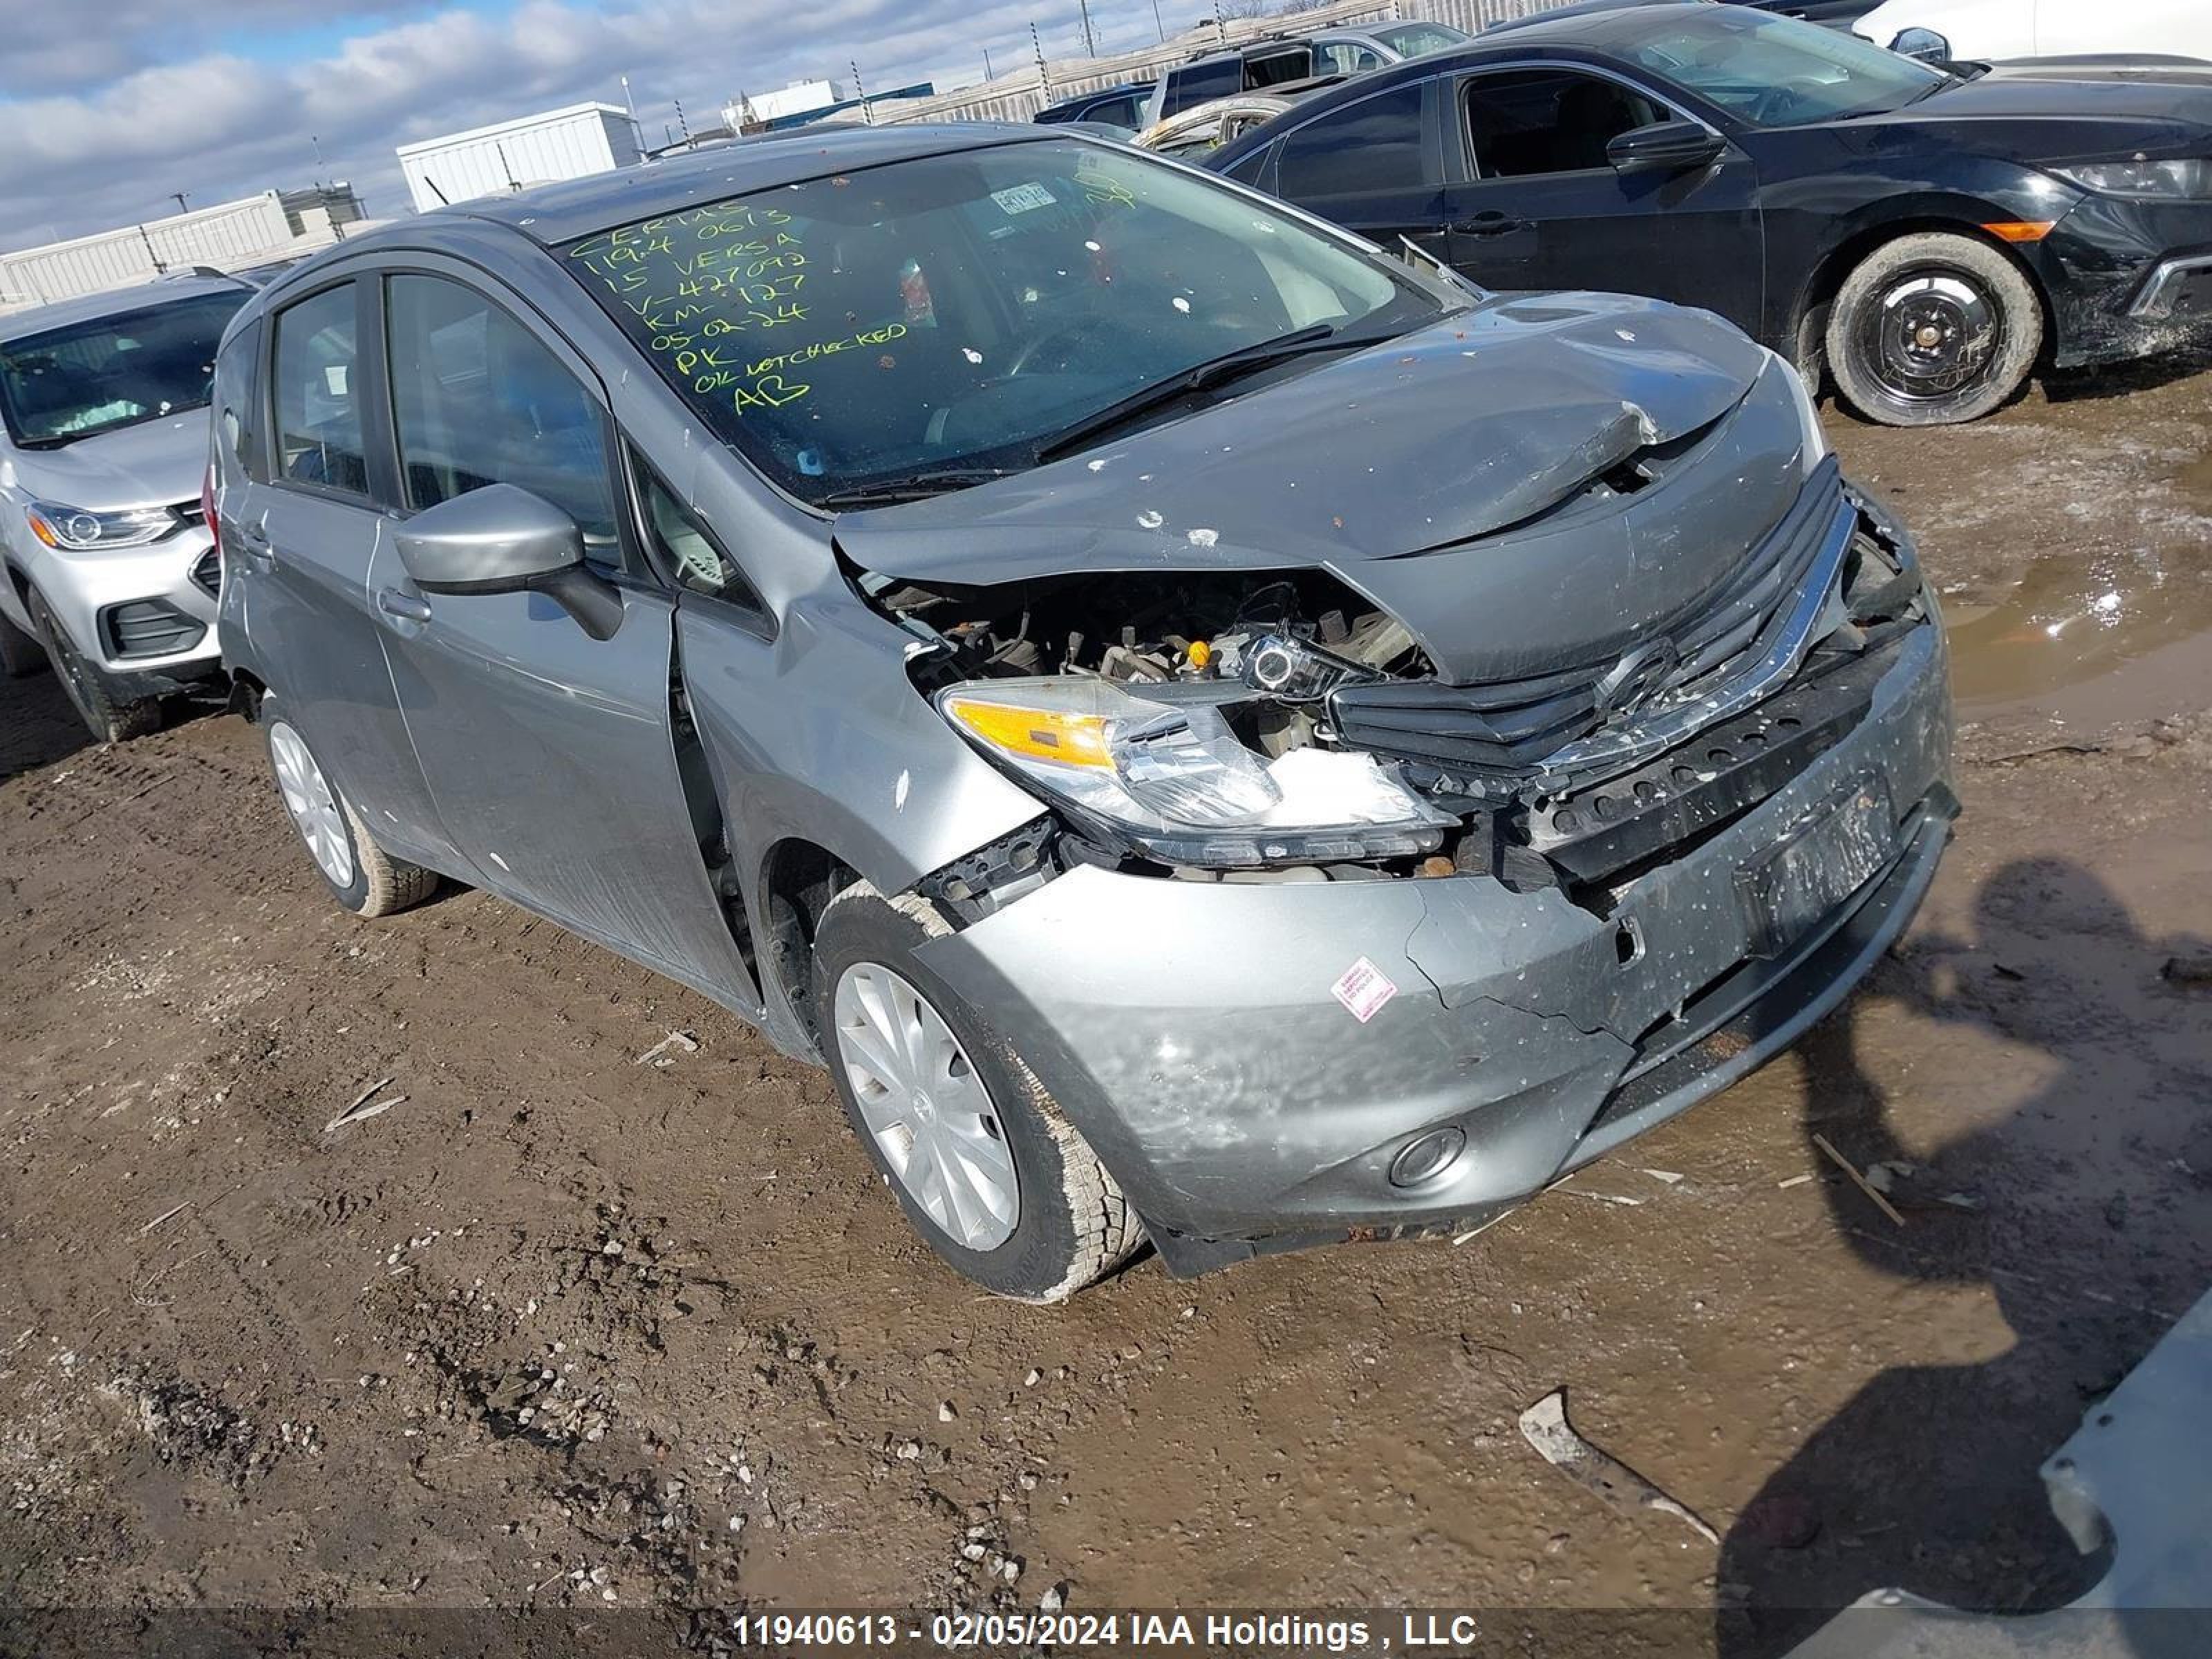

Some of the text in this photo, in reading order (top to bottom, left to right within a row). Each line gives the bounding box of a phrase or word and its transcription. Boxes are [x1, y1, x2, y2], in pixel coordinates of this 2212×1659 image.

[674, 232, 803, 276] VERSA
[642, 274, 805, 332] KM 127
